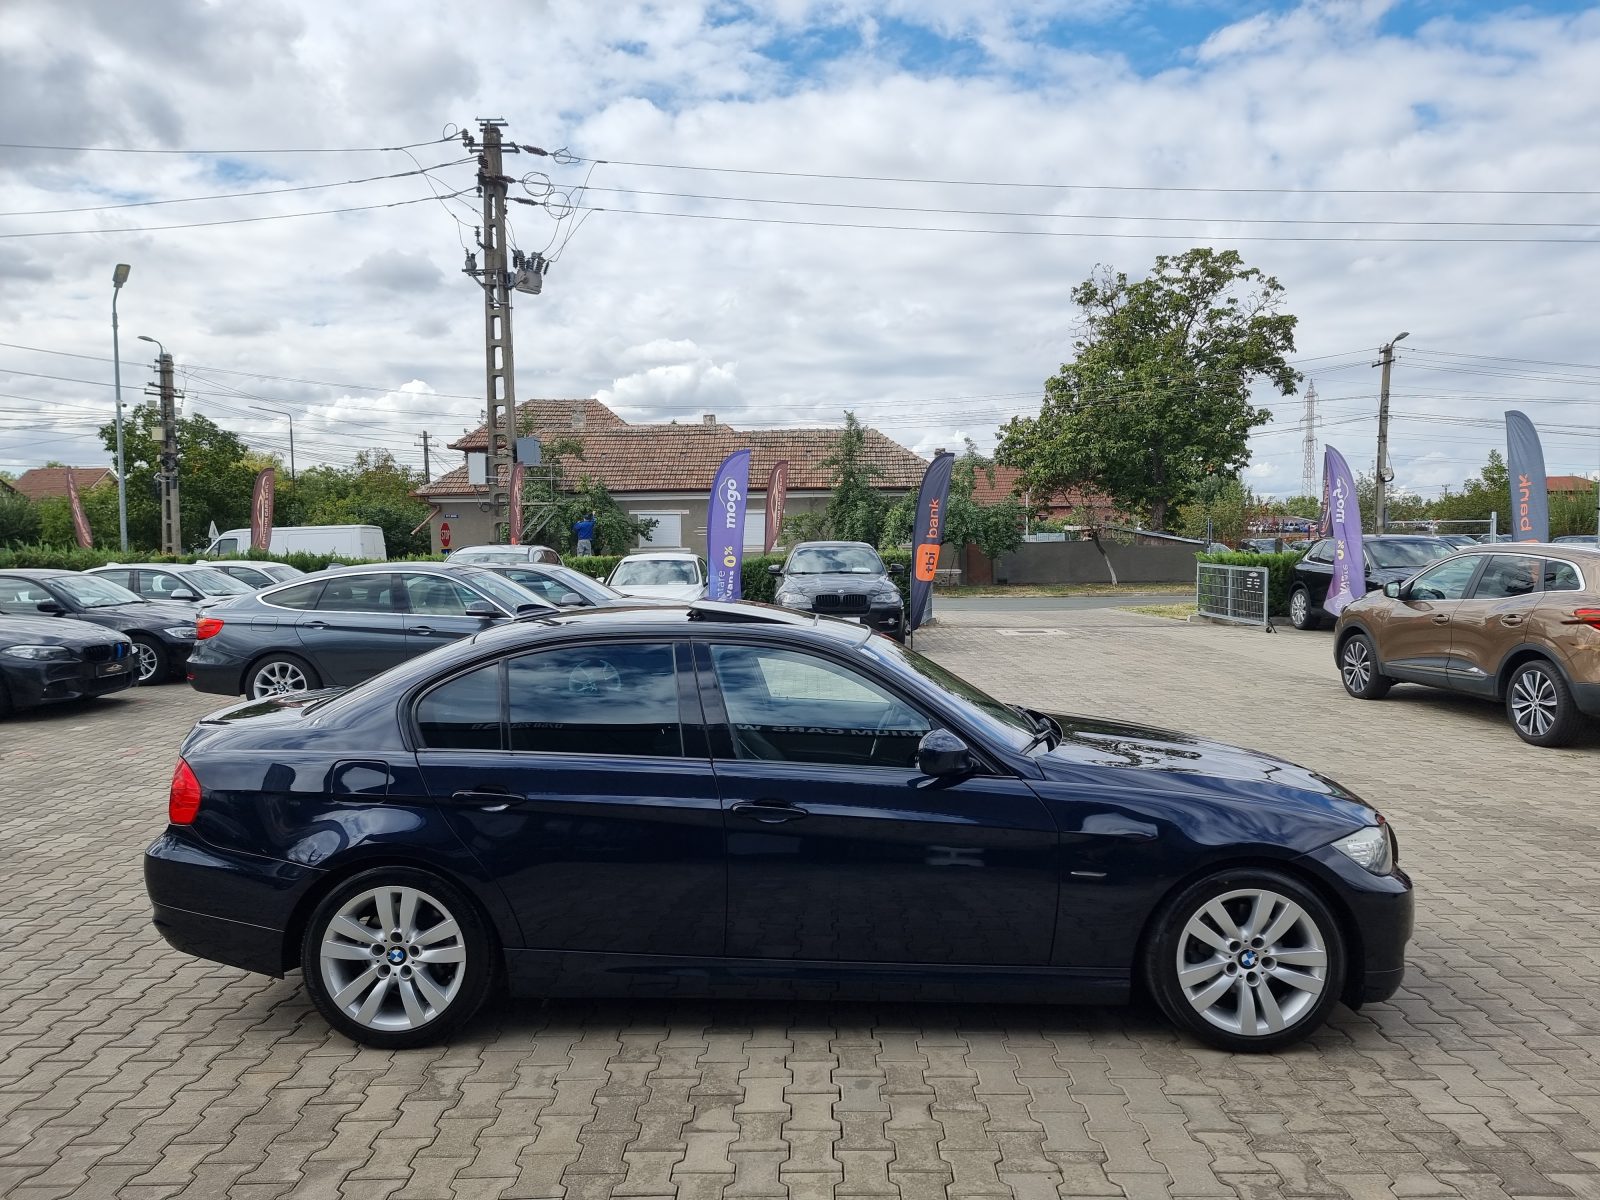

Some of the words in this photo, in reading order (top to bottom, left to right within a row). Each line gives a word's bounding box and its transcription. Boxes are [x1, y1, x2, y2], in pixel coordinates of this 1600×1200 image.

[726, 478, 741, 529] mogo
[927, 498, 939, 539] bank
[441, 529, 450, 540] STOP
[925, 551, 936, 574] tbi
[717, 570, 726, 598] ntare
[726, 570, 734, 600] vans
